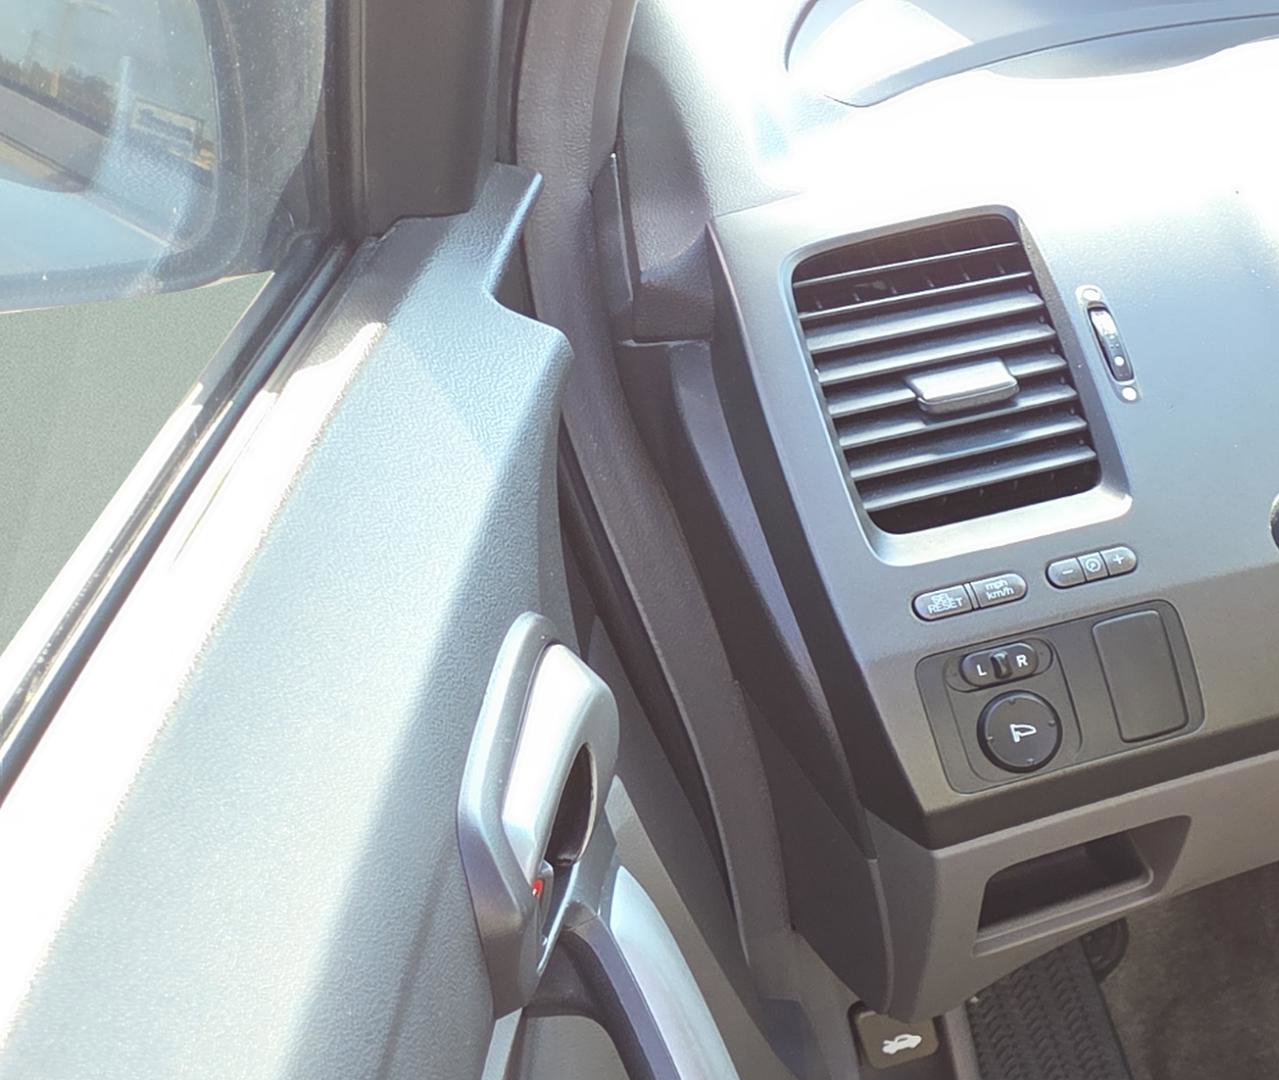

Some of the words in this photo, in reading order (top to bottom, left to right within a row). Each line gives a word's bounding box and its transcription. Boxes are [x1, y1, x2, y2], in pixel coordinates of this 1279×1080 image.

[986, 587, 1015, 600] km/h
[927, 597, 963, 614] RESET
[976, 663, 987, 676] L
[1015, 654, 1028, 668] R
